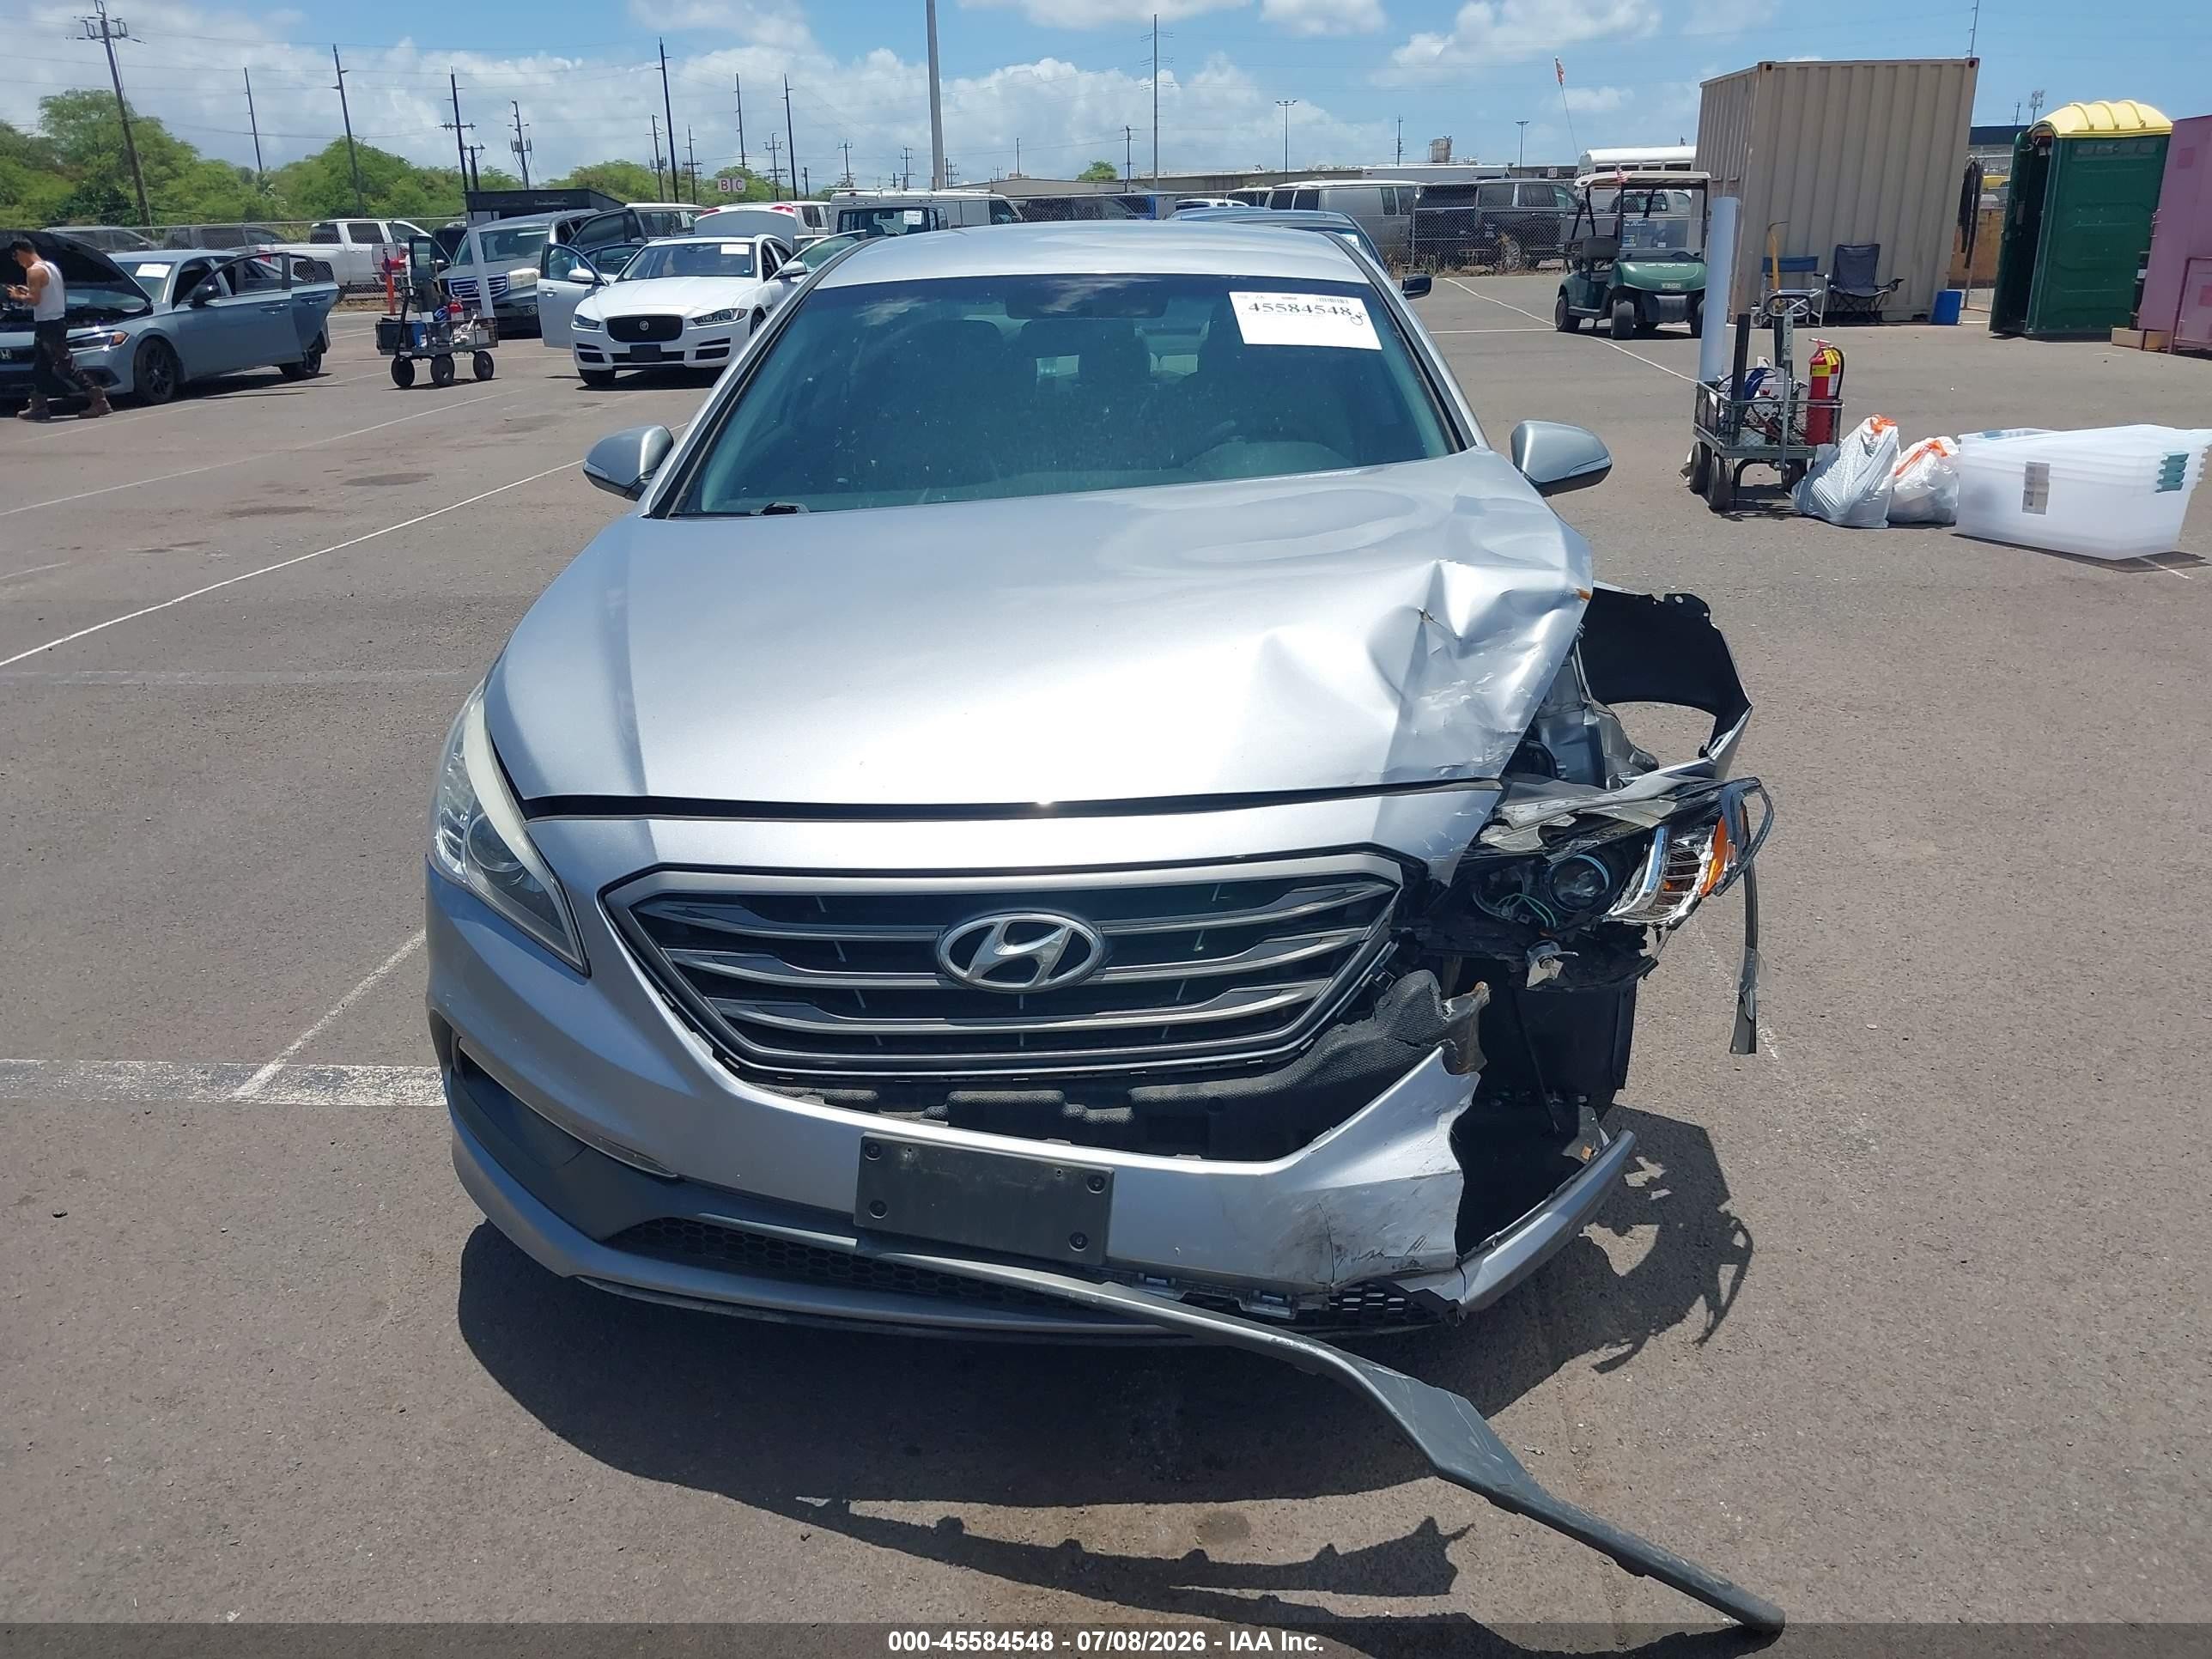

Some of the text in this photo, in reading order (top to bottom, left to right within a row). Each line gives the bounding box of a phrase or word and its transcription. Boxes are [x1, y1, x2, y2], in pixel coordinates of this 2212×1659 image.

[721, 179, 743, 191] B C
[1249, 302, 1352, 317] 45584548
